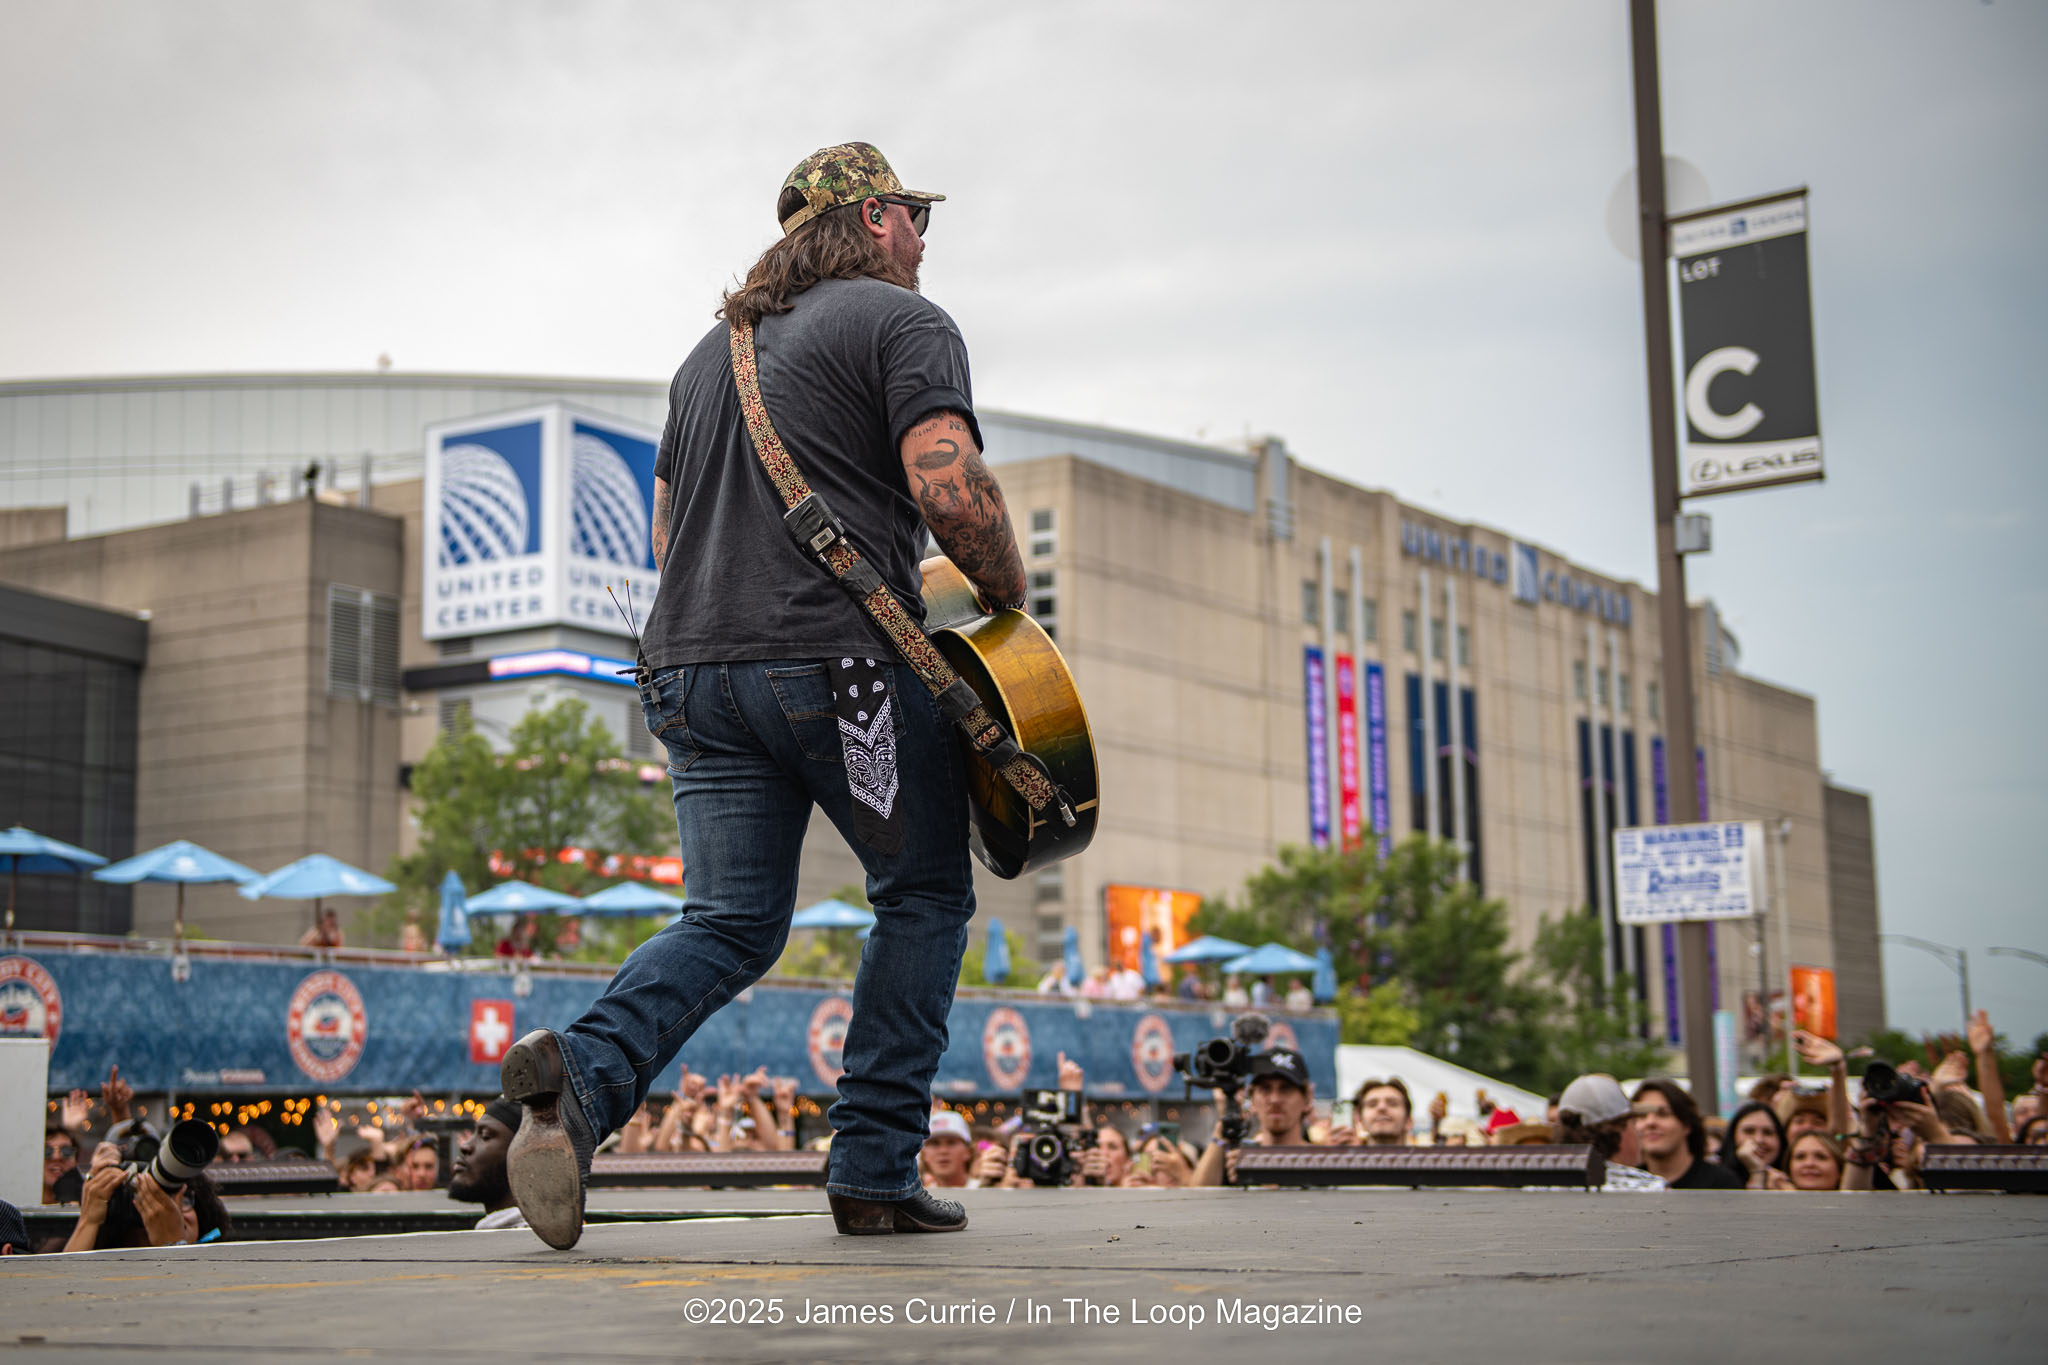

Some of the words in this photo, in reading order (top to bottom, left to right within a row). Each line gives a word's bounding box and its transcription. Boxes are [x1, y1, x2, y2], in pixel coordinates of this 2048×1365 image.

[1681, 256, 1721, 283] LOT
[1685, 345, 1765, 440] C
[1725, 449, 1817, 473] LEXUS
[438, 566, 544, 599] UNITED
[1402, 518, 1508, 586] UNITED
[1543, 568, 1631, 626] CENTER
[438, 594, 543, 627] CENTER
